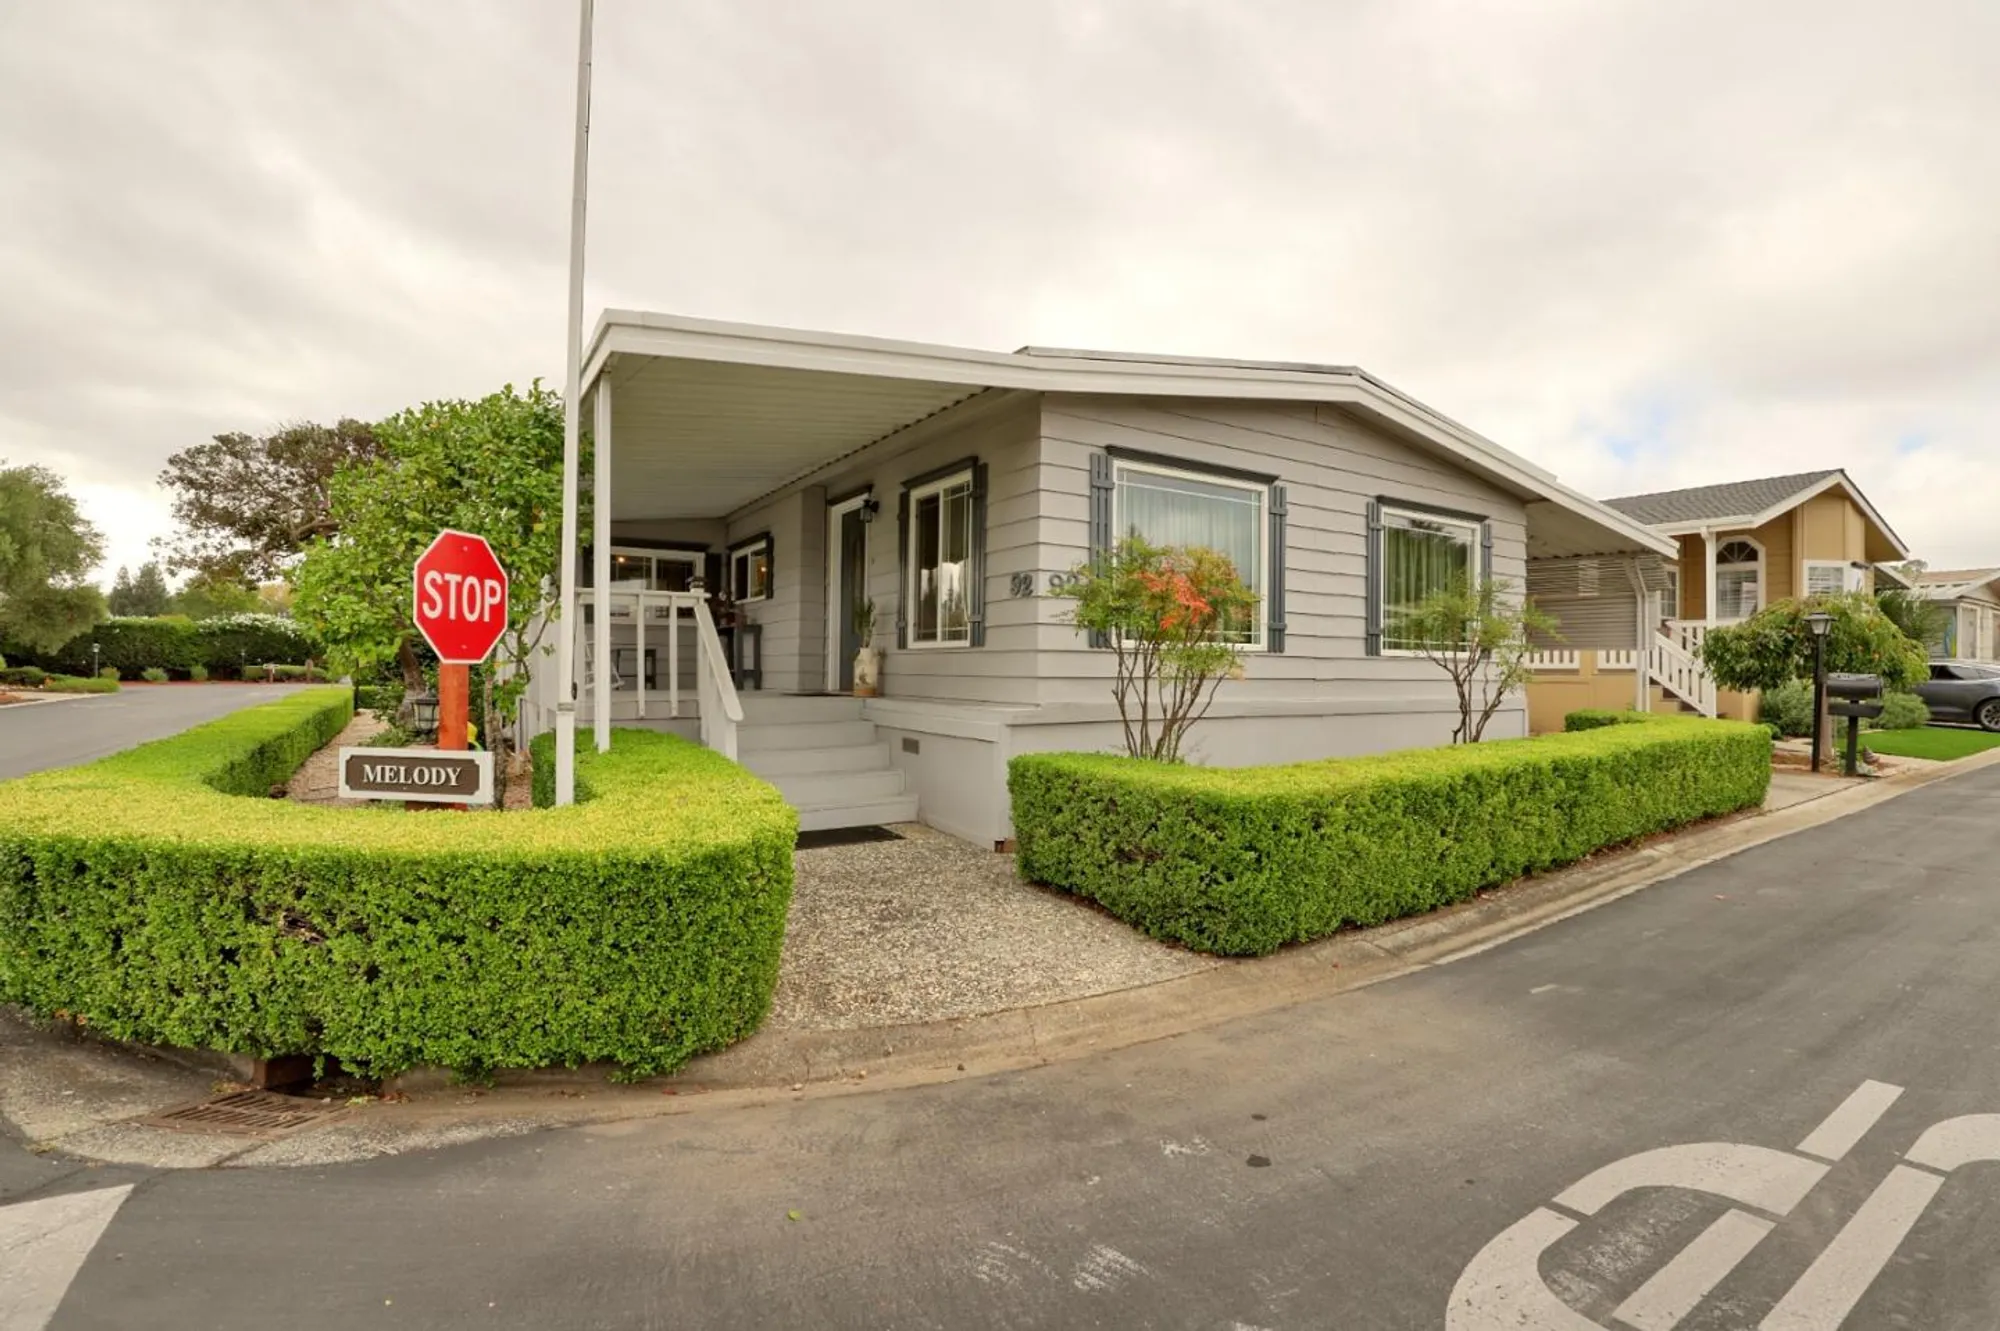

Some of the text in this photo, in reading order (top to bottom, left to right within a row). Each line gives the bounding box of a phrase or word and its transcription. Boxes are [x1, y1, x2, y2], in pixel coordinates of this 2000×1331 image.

[422, 570, 501, 622] STOP
[1010, 572, 1034, 597] 92
[363, 764, 462, 787] MELODY
